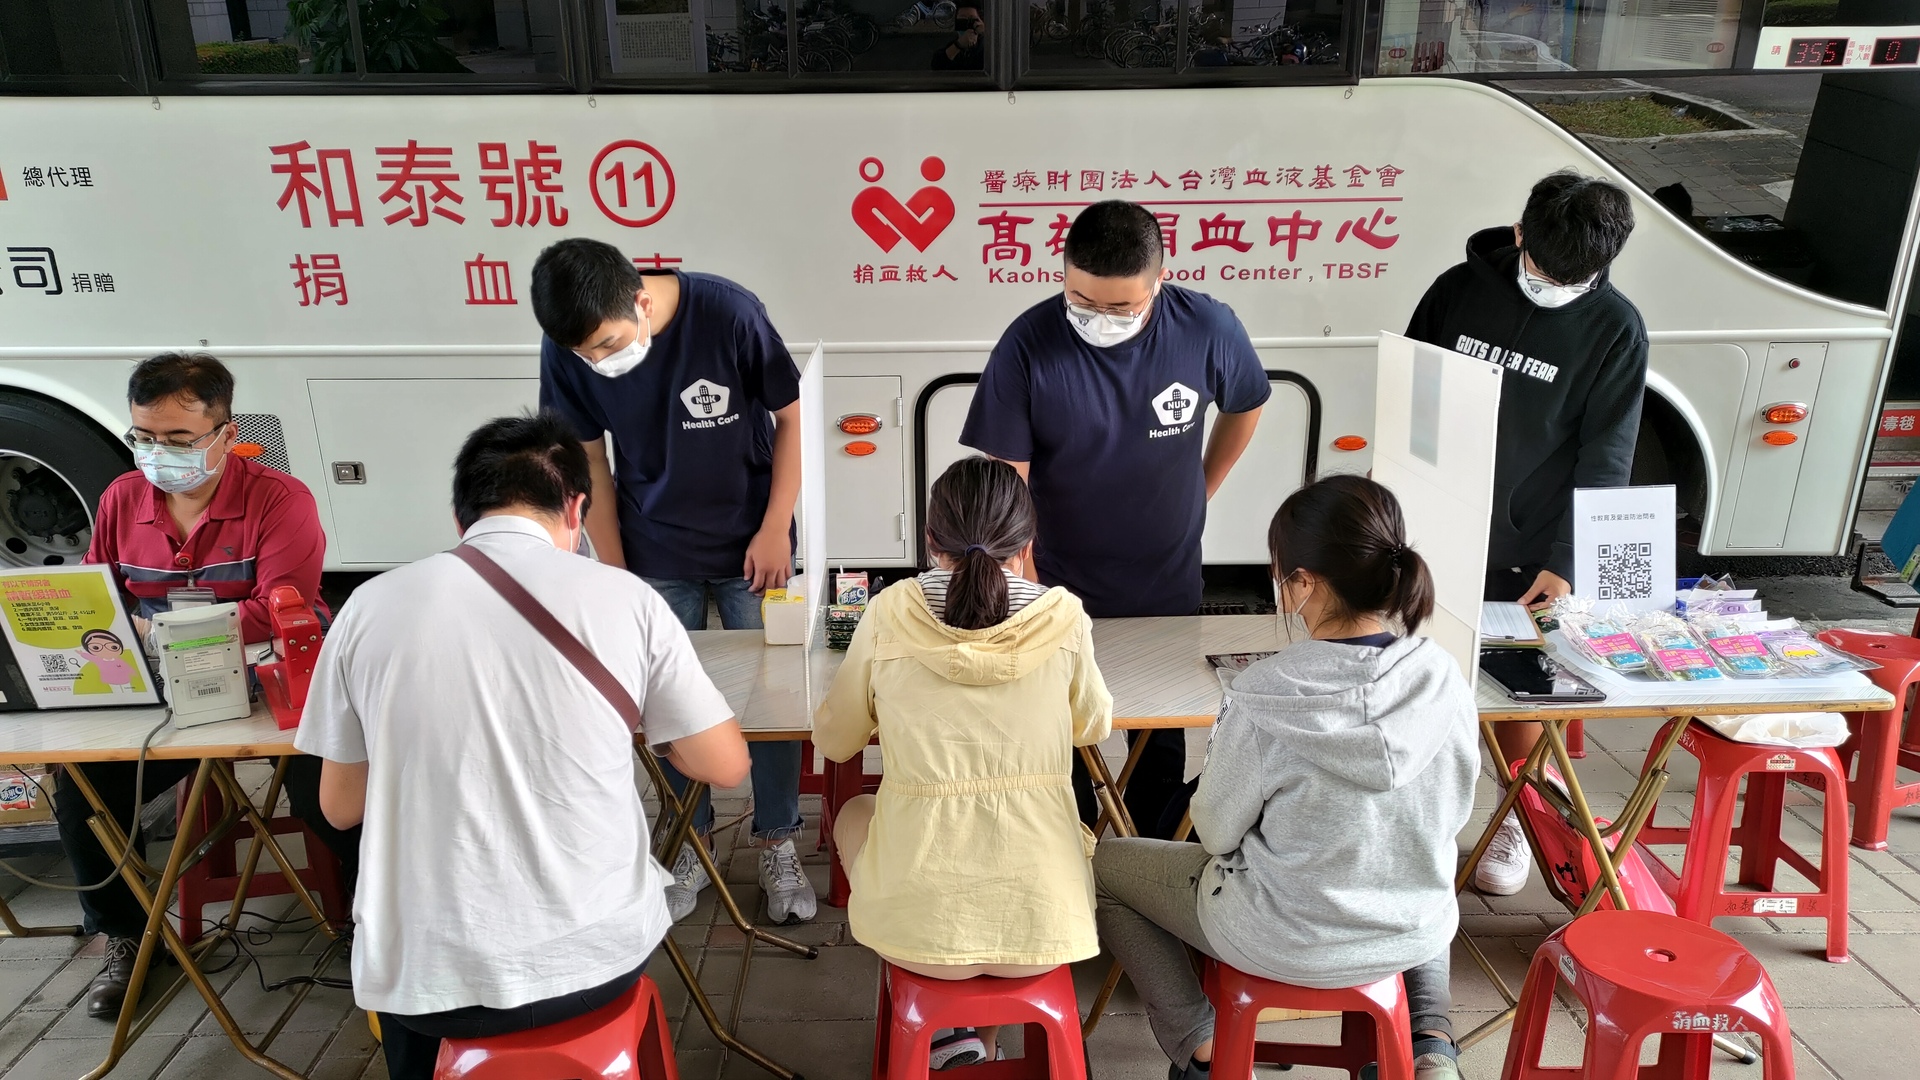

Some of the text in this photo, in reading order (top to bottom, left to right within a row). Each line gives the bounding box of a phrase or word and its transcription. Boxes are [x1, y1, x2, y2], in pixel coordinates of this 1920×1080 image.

[1794, 42, 1838, 64] 355
[1885, 41, 1901, 61] 0
[22, 166, 94, 187] 總代理
[268, 139, 568, 228] 和泰號
[979, 164, 1405, 194] 醫療財團法人台灣血液基金會
[0, 247, 115, 295] 司 捐贈
[853, 263, 959, 285] 捐血救人
[989, 267, 1065, 284] Kaohs
[1163, 265, 1206, 282] ood
[1322, 262, 1389, 279] TBSF
[1455, 334, 1490, 360] GUTS
[1521, 357, 1559, 383] FEAR
[695, 395, 716, 404] NUK
[1167, 400, 1187, 410] NUK
[682, 413, 740, 430] Health Care
[1149, 426, 1181, 438] Health
[1879, 415, 1916, 432] 毒毯
